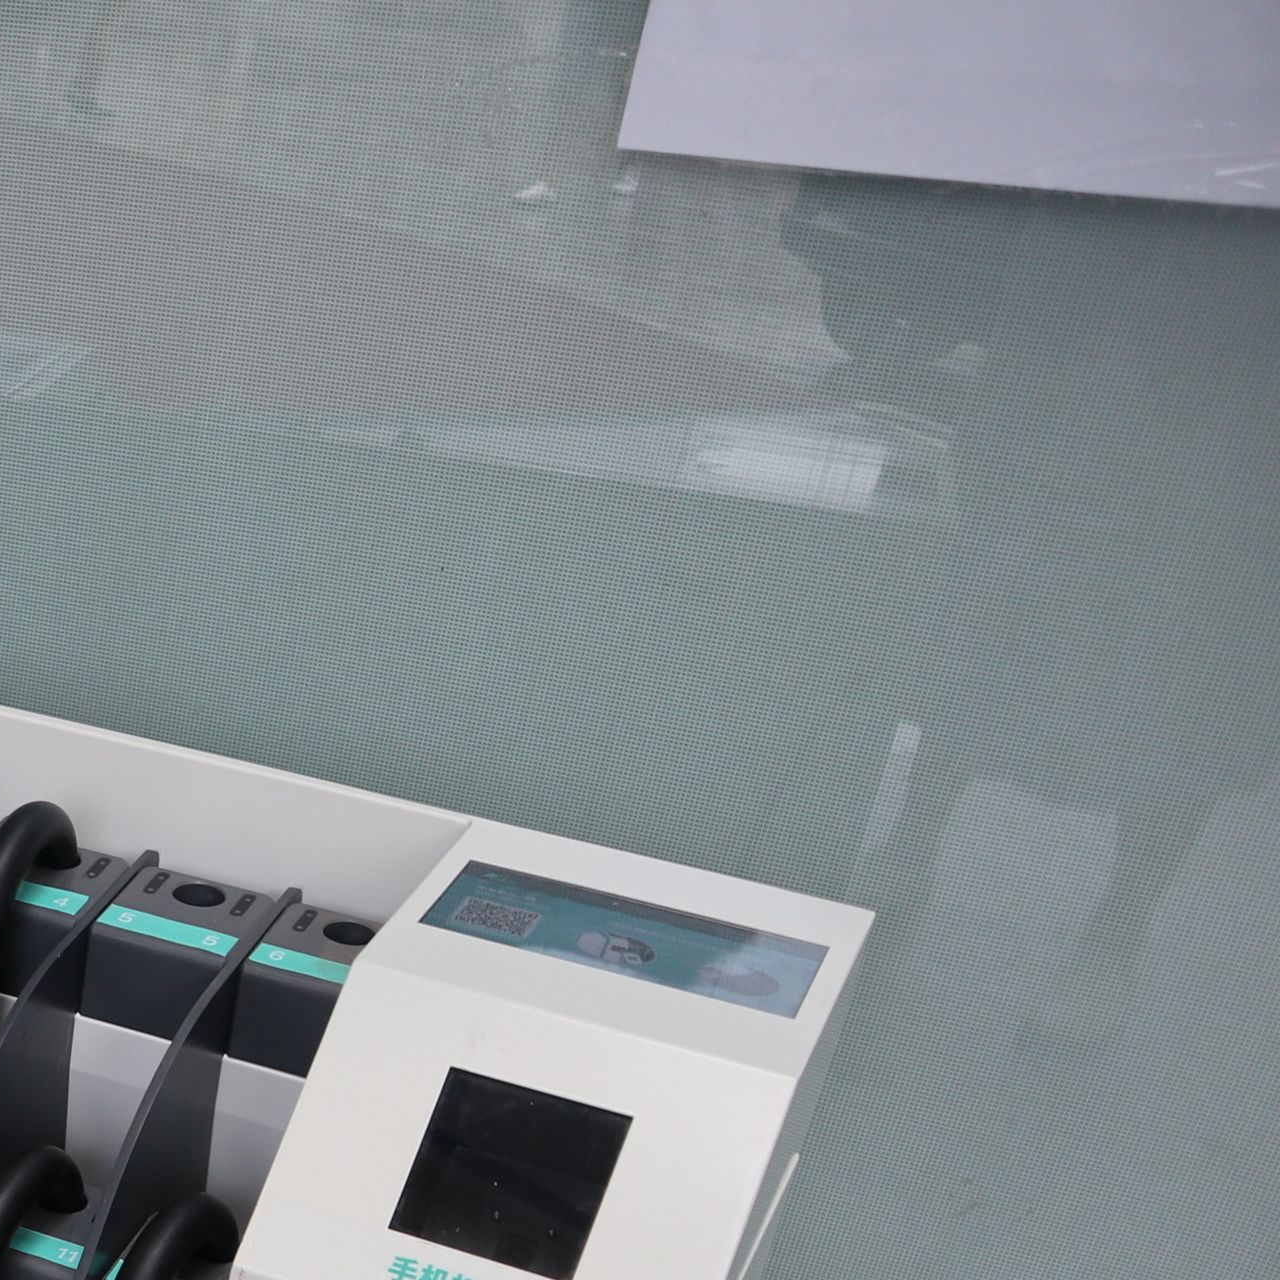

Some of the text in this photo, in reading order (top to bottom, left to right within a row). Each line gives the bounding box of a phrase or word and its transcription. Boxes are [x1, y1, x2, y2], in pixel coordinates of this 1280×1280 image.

[53, 897, 69, 907] 4
[118, 912, 135, 923] 5
[202, 934, 220, 946] 5
[269, 950, 286, 961] 6
[58, 1247, 78, 1262] 11
